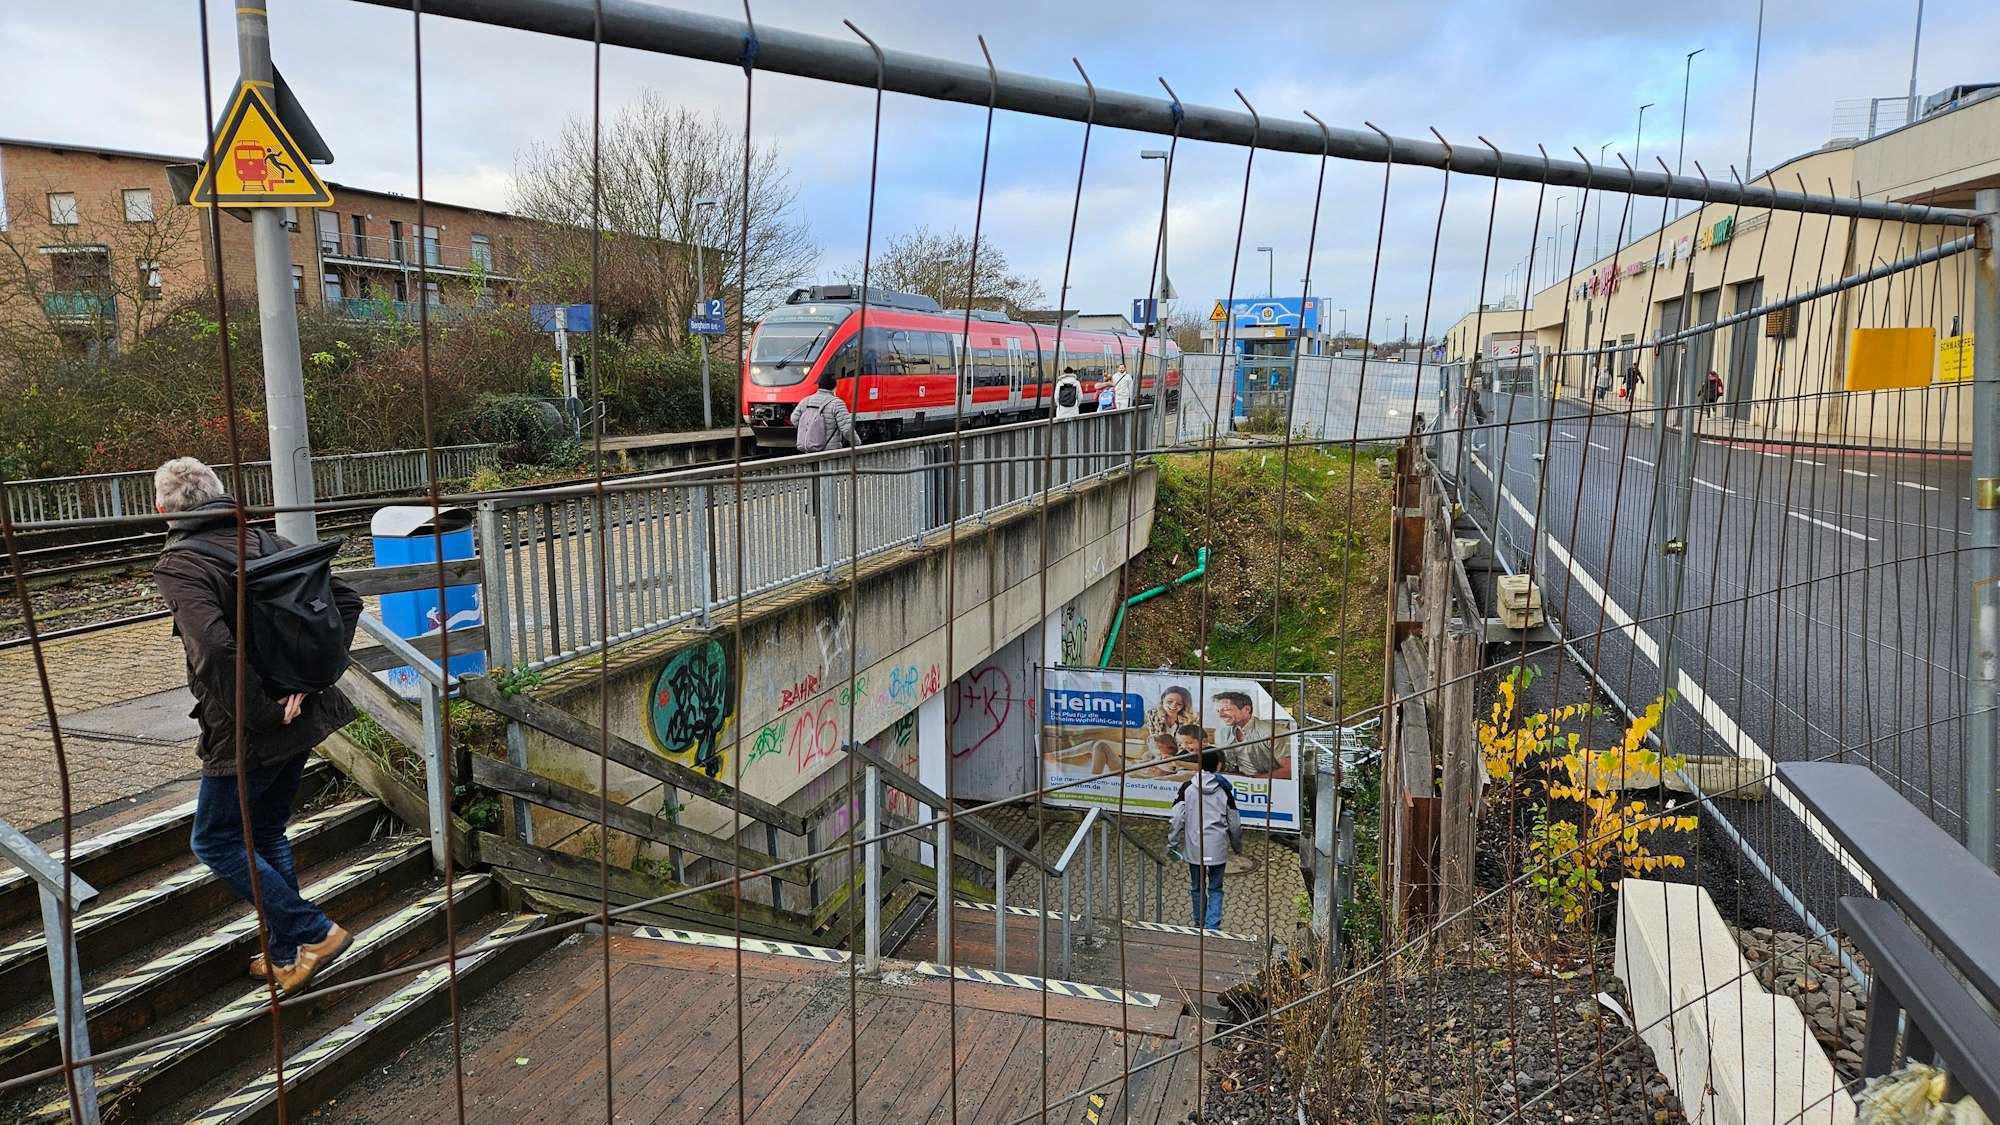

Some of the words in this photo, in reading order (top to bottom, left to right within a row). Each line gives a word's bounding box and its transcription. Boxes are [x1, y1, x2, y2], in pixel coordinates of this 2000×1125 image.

[711, 299, 721, 315] 2
[1136, 300, 1145, 318] 1
[690, 320, 710, 331] Bergheim
[778, 664, 822, 712] BAHR!
[1049, 692, 1132, 713] Heim+
[1077, 711, 1087, 719] für
[788, 698, 838, 774] 126
[1125, 782, 1158, 790] Gastarife
